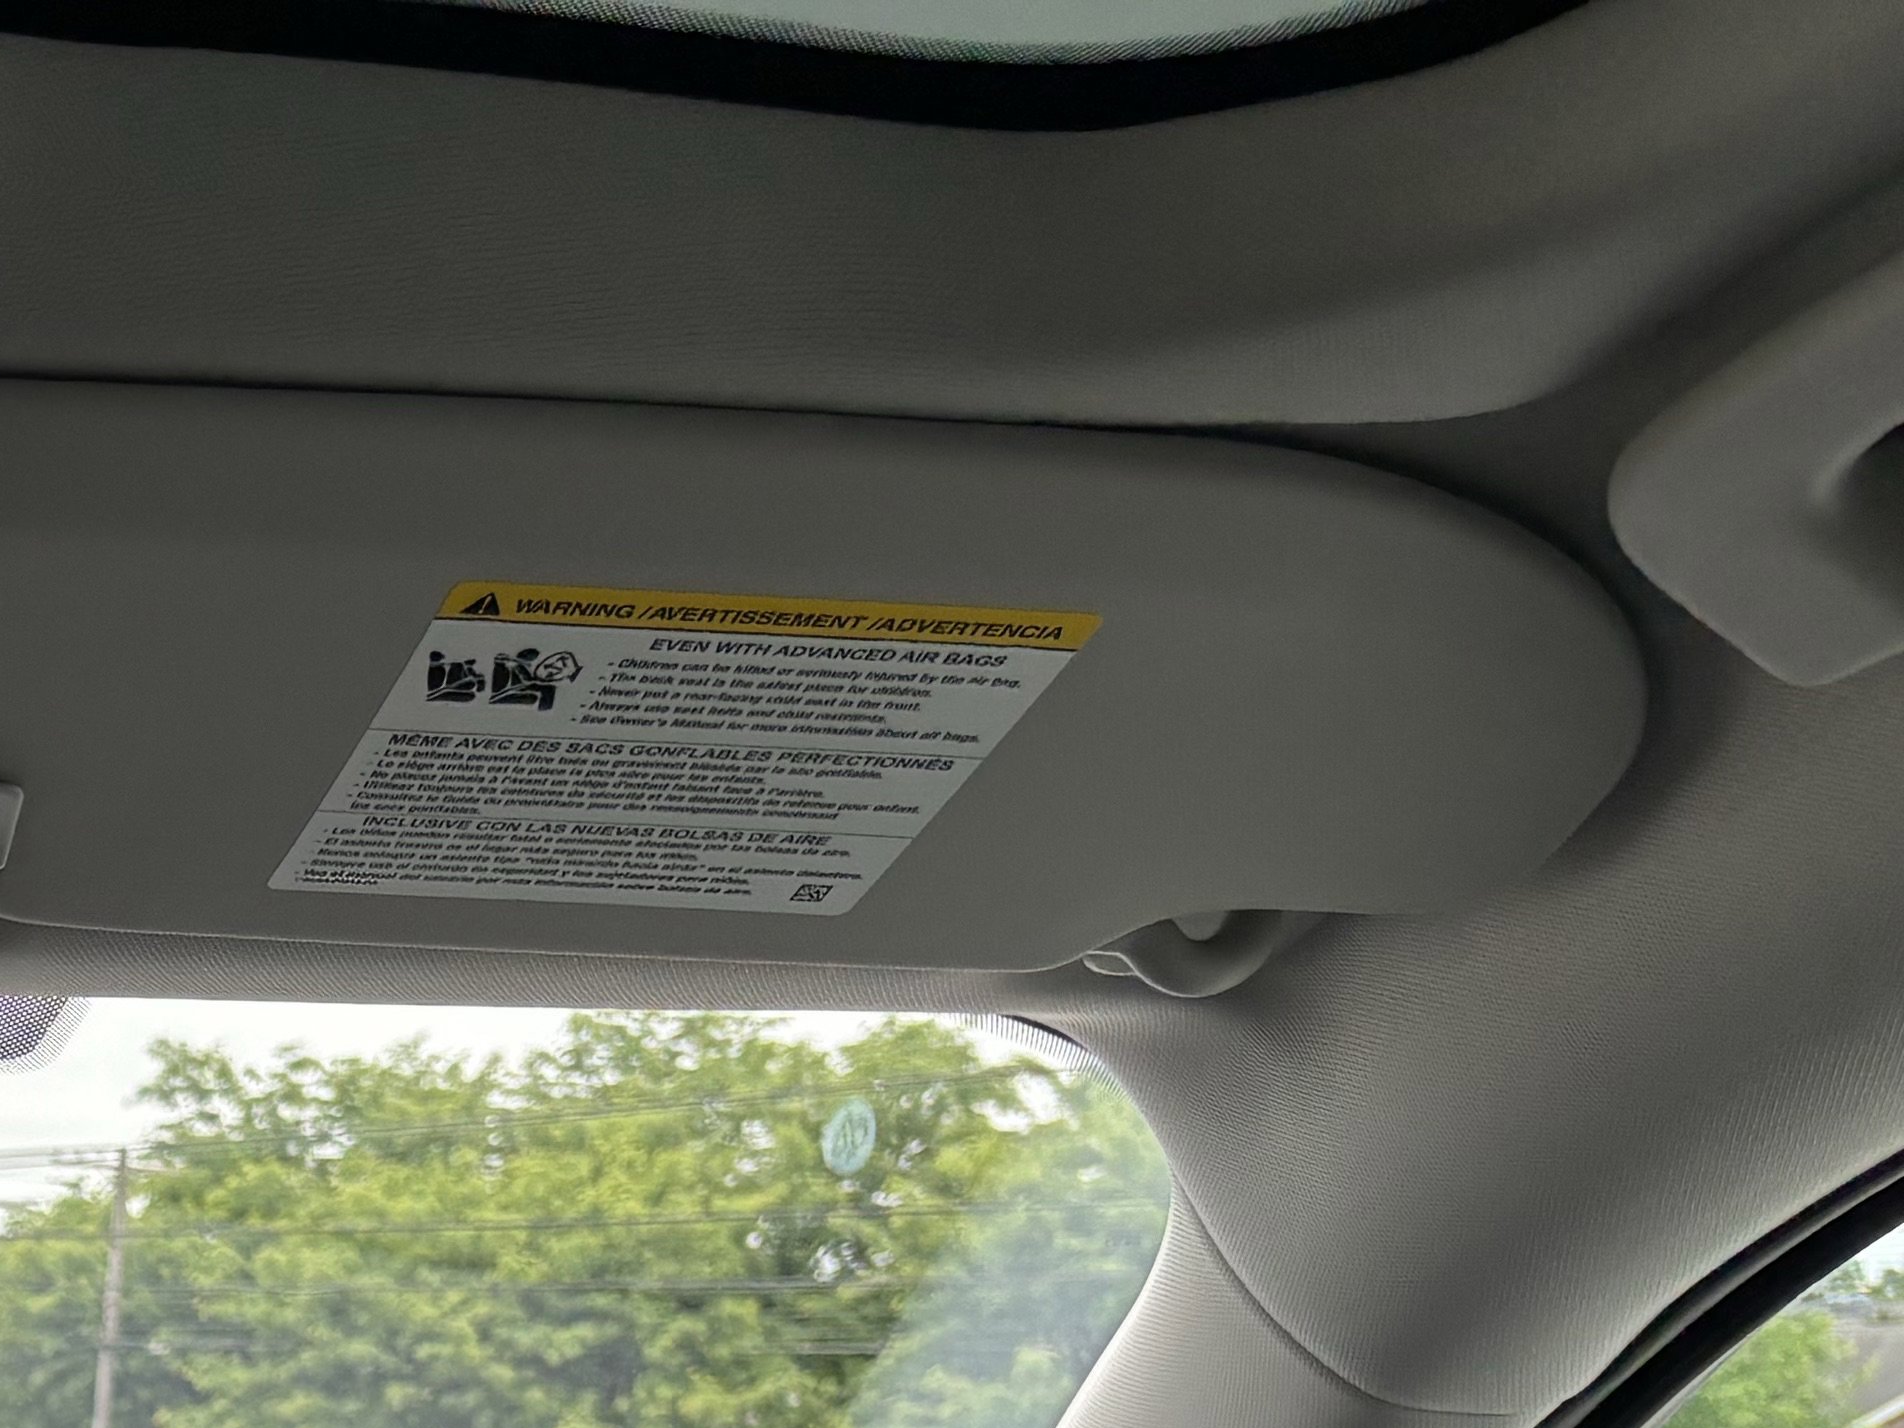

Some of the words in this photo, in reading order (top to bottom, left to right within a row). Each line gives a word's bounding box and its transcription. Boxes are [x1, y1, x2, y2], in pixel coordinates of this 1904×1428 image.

[516, 598, 635, 620] WARNING
[650, 638, 711, 655] EVEN
[715, 640, 774, 657] WITH
[778, 643, 896, 663] ADVANCED
[899, 649, 940, 664] AIR
[944, 652, 1008, 668] BAGS
[388, 732, 453, 748] MÊME
[456, 737, 515, 751] AVEC
[522, 738, 560, 754] DES
[565, 742, 624, 756] SACS
[629, 744, 773, 763] GONFLABLES
[777, 750, 955, 771] PERFECTIONNÉS
[362, 815, 472, 832] INCLUSIVE
[478, 818, 519, 833] CON
[526, 820, 565, 835] LAS
[572, 823, 655, 839] NUEVAS
[659, 829, 744, 844] BOLSAS
[748, 831, 778, 845] DE
[783, 833, 832, 847] AIRE
